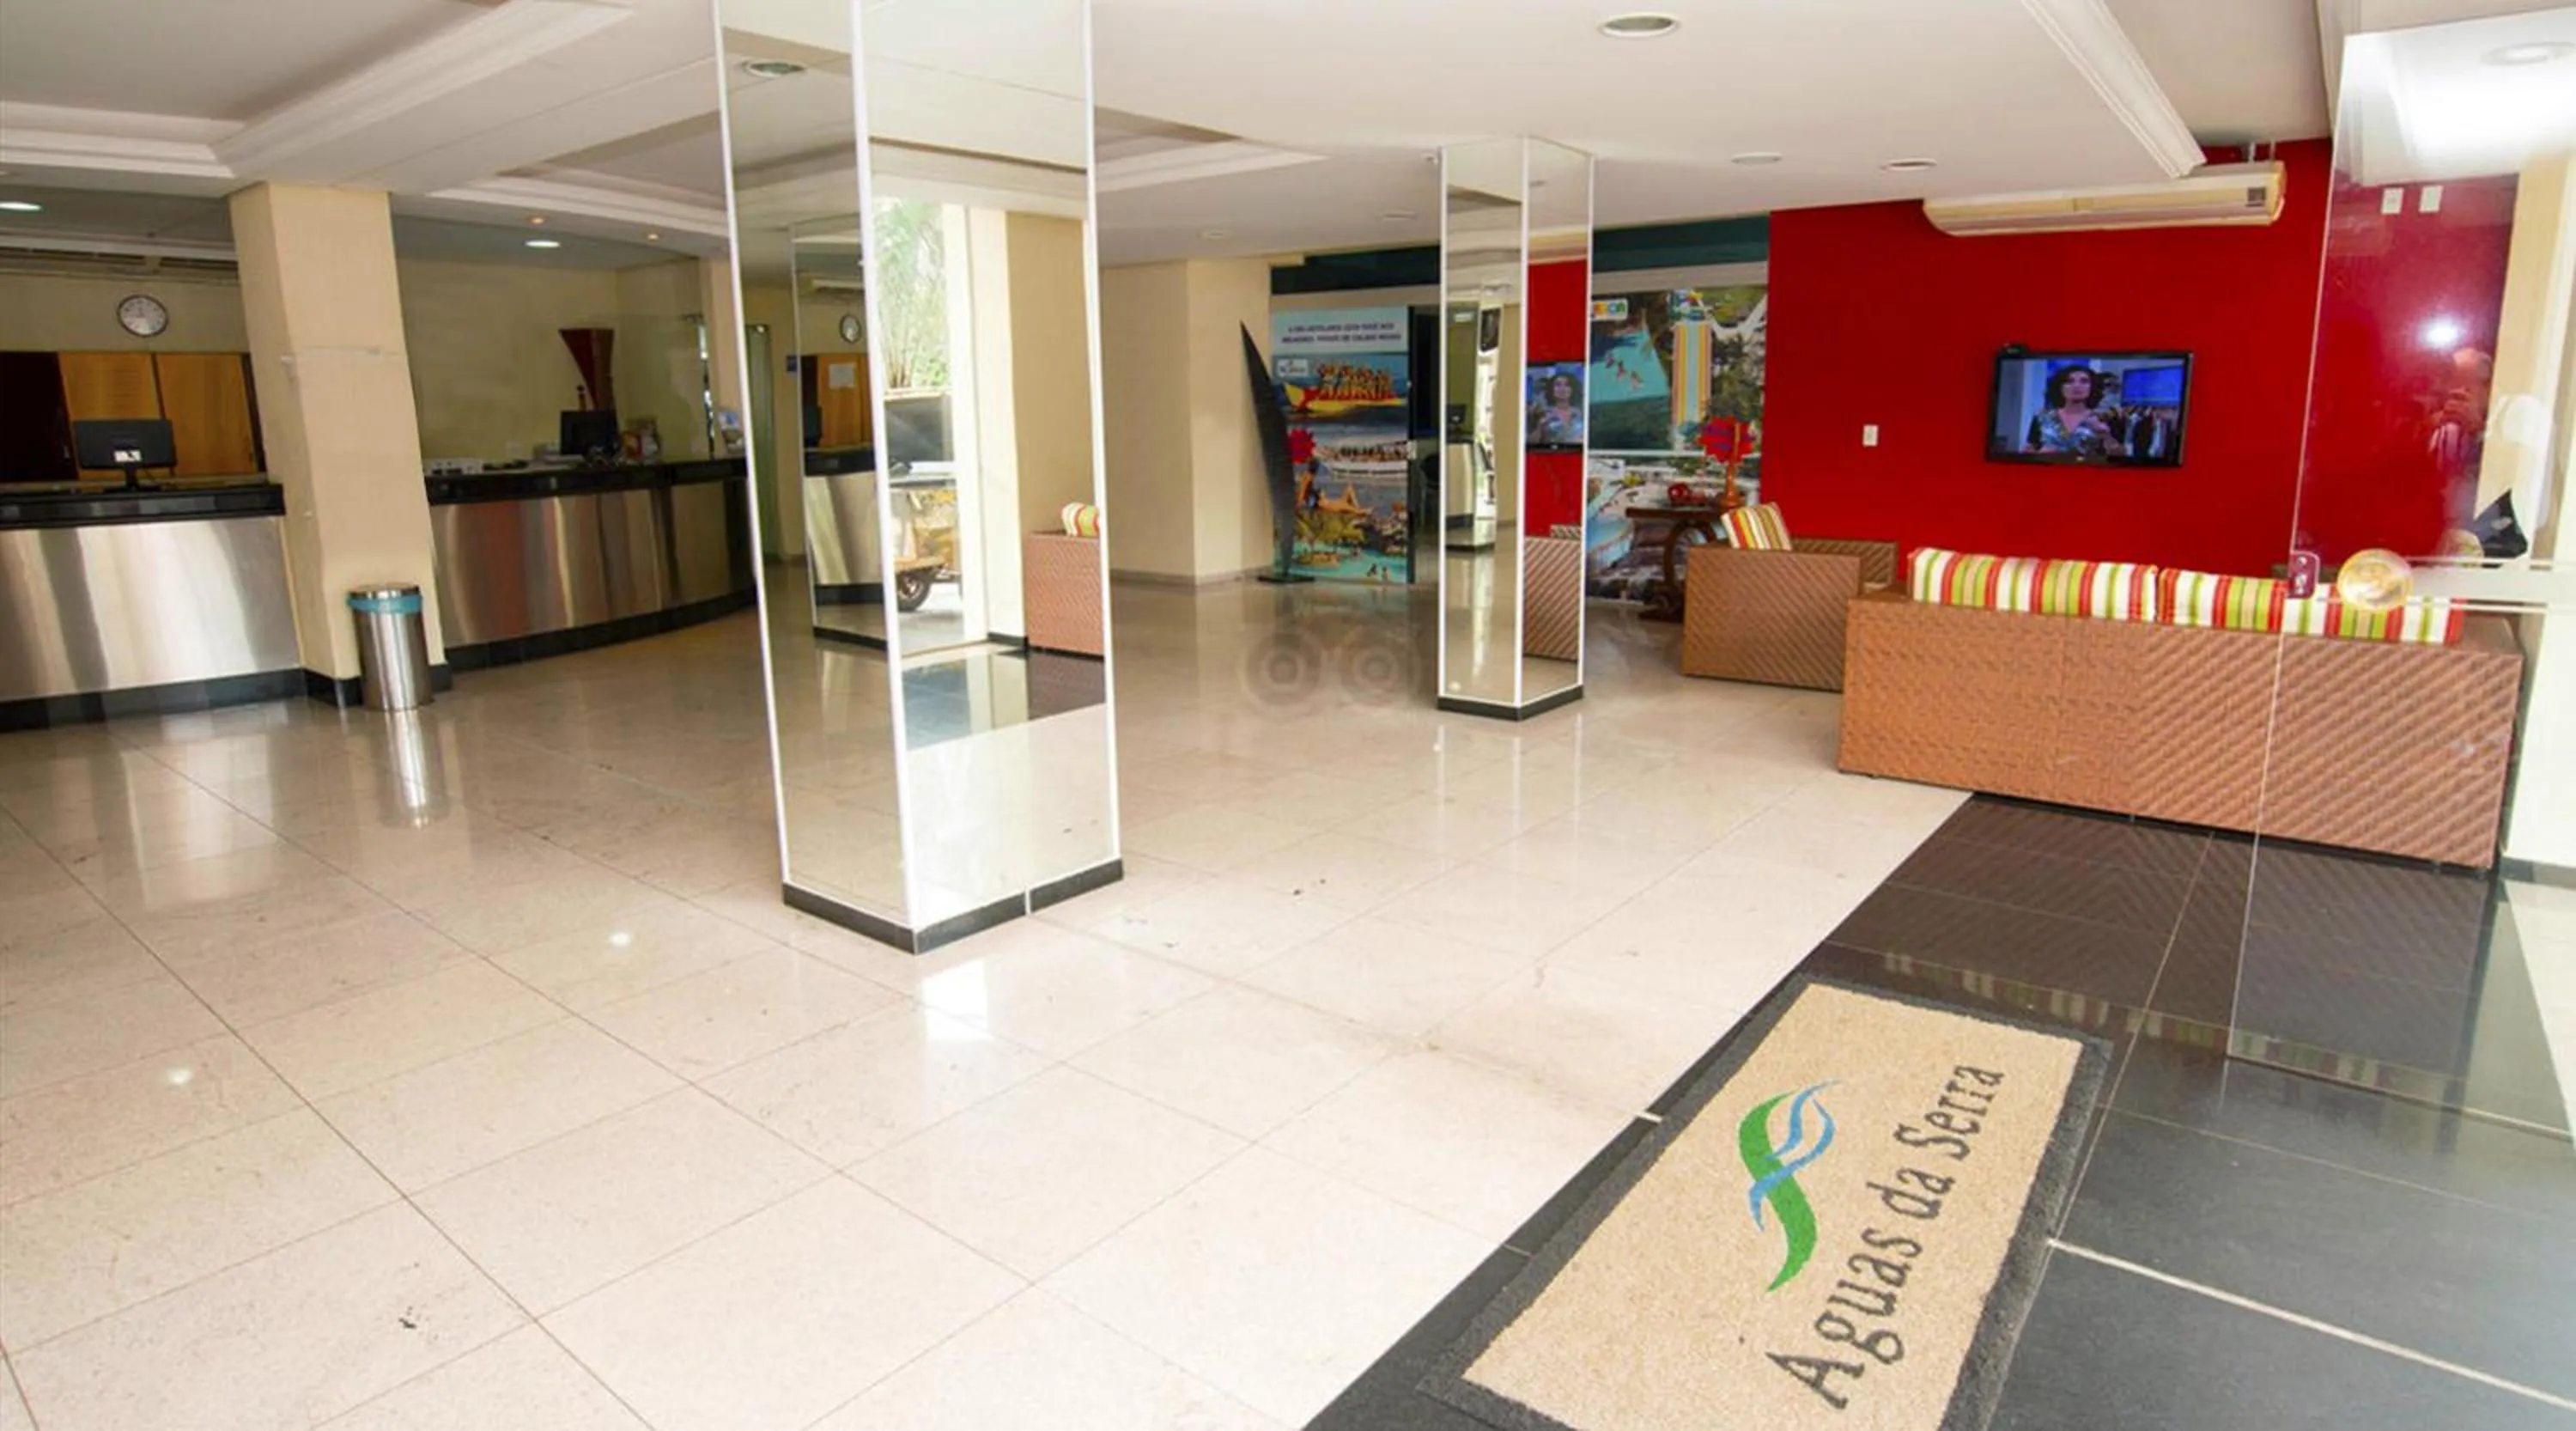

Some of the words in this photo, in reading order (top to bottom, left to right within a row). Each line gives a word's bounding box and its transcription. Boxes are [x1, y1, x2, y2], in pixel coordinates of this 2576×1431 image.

[1892, 1065, 2006, 1161] Serra
[1866, 1168, 1957, 1220] da
[1765, 1227, 1924, 1410] Aguas
